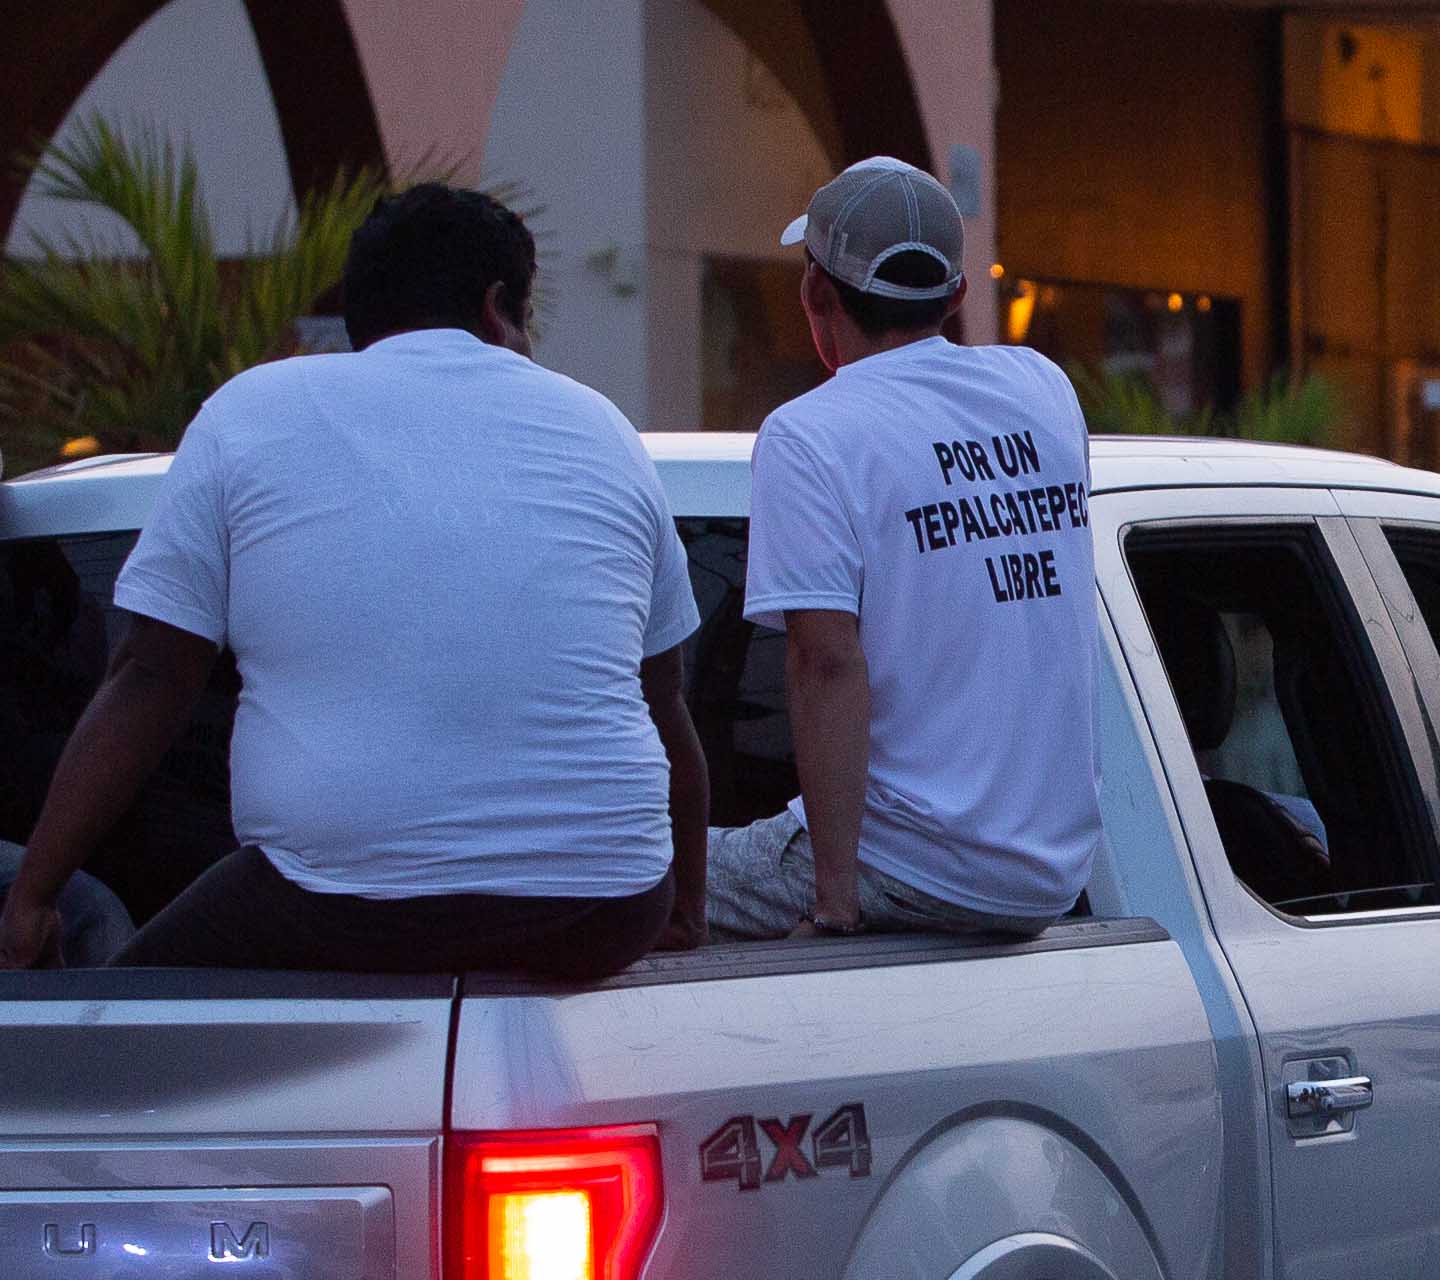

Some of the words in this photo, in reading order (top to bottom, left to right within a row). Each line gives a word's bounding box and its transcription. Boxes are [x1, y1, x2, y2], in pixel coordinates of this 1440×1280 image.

[932, 440, 995, 485] POR
[991, 430, 1041, 478] UN
[905, 481, 1089, 554] TEPALCATEPEC
[985, 550, 1061, 603] LIBRE
